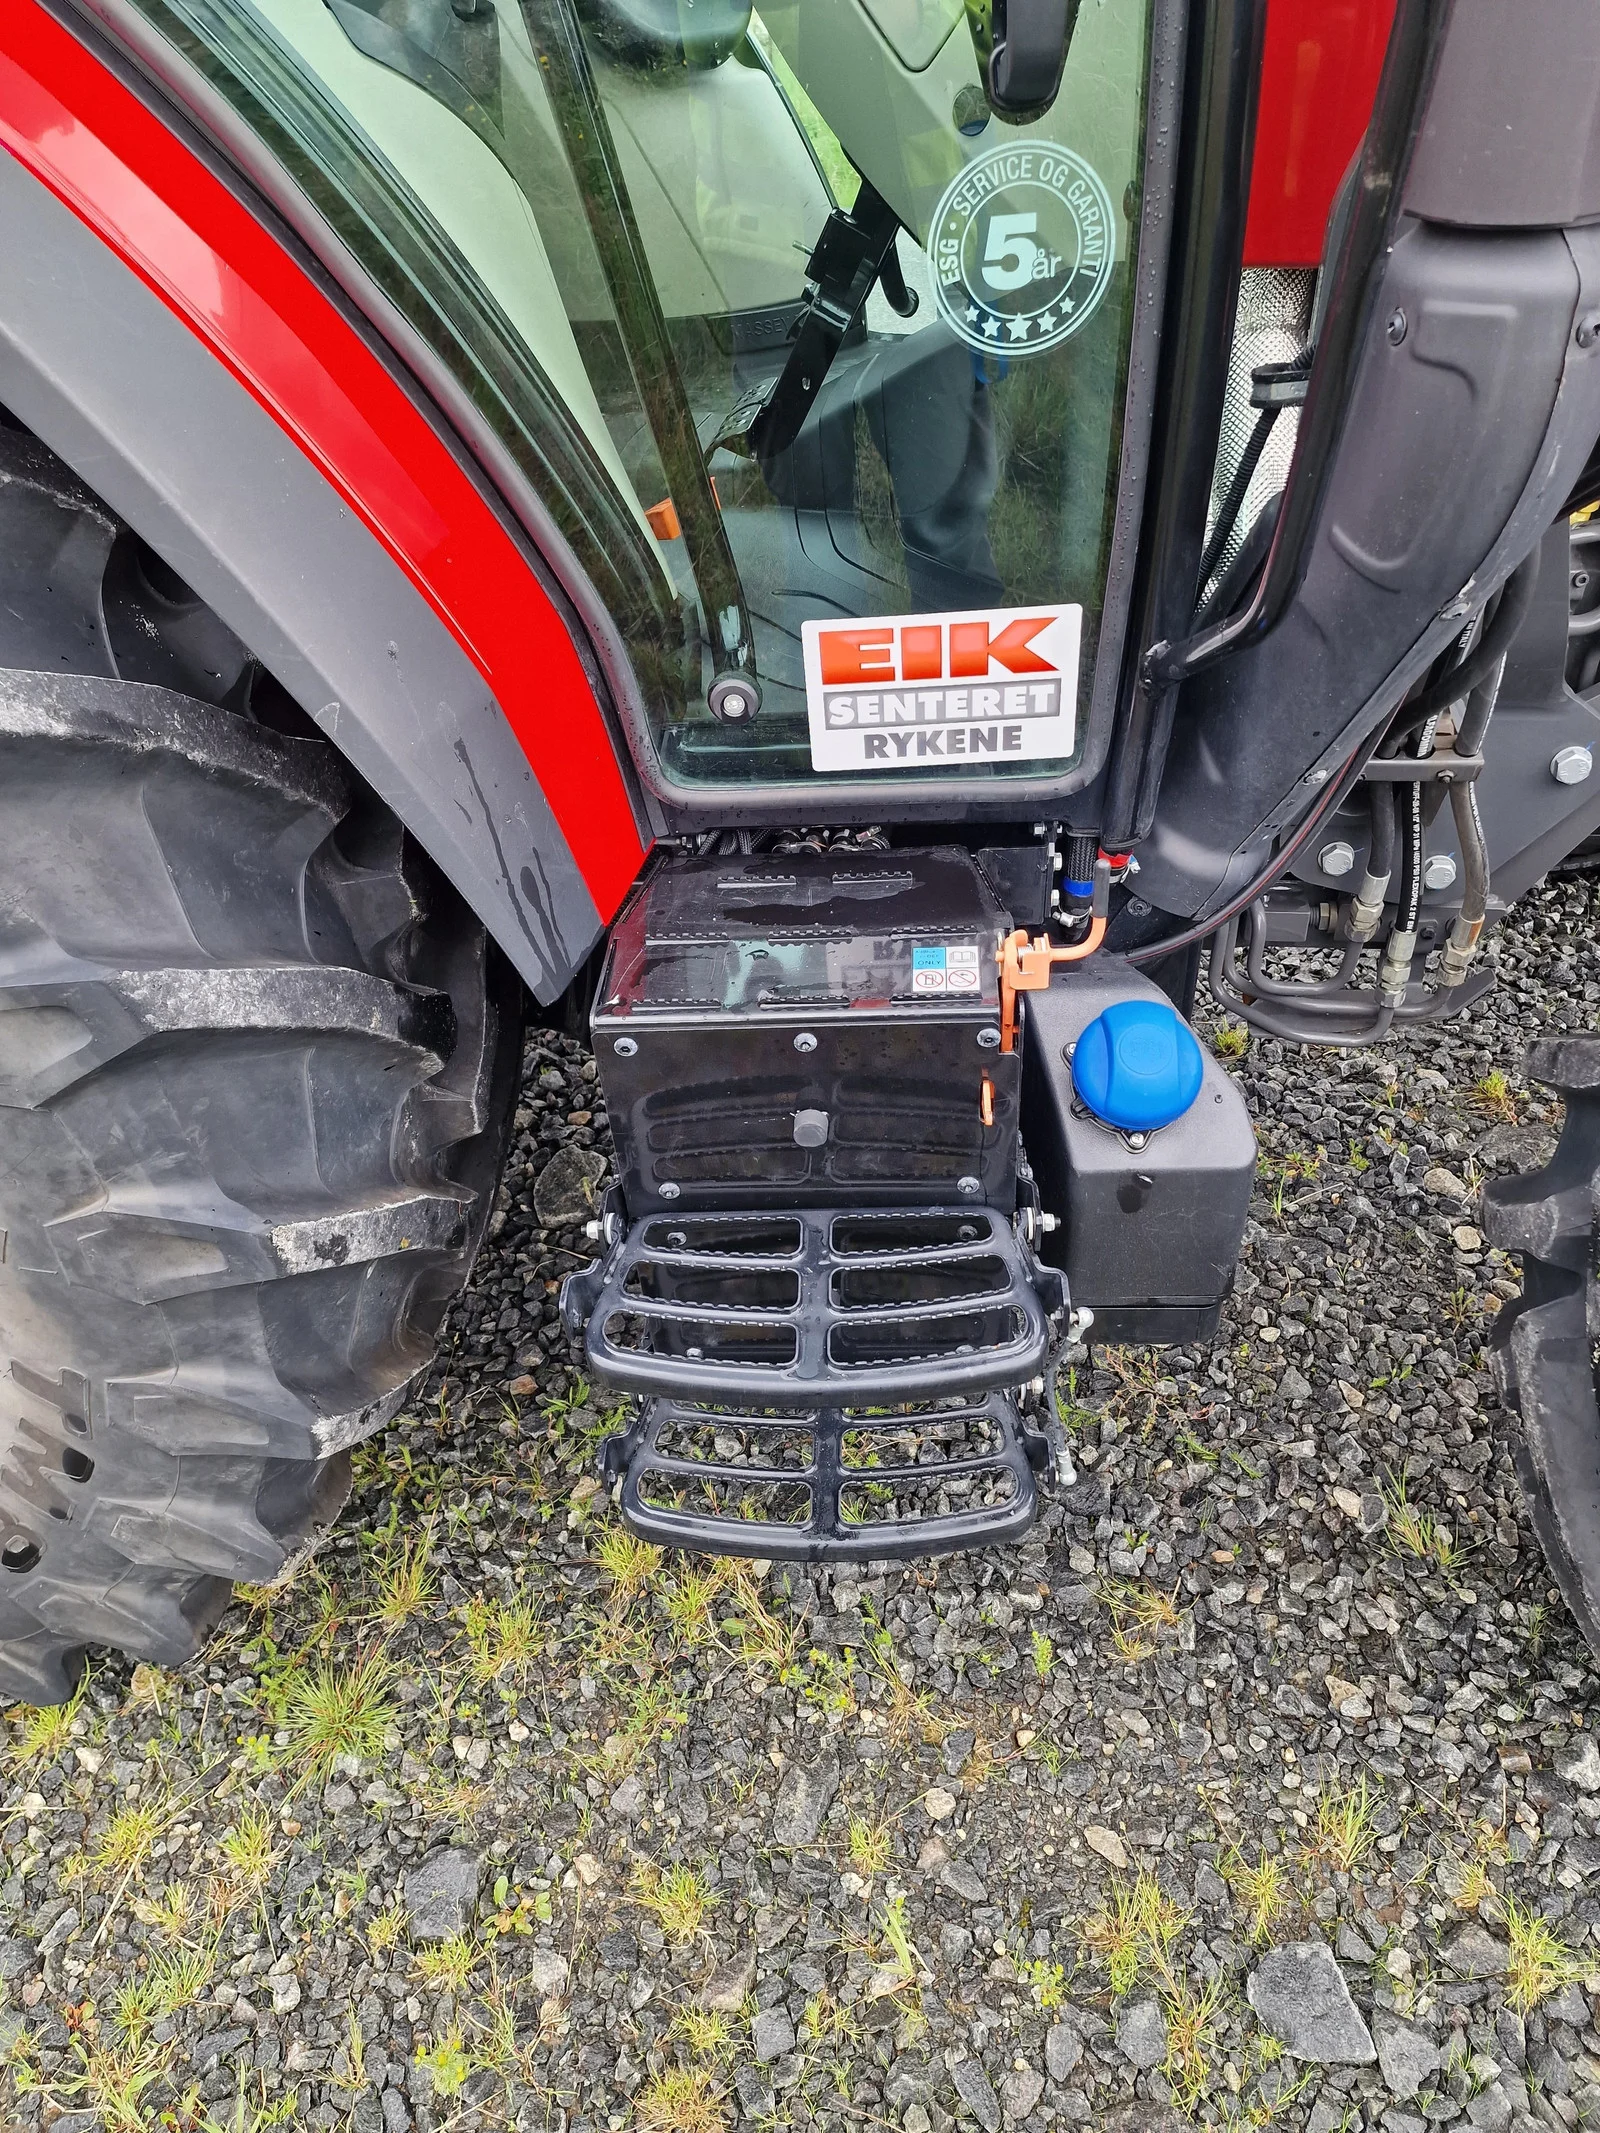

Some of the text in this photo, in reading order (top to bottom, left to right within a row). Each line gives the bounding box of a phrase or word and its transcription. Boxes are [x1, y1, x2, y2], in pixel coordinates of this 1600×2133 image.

[939, 155, 1105, 287] ESG SERVICE OG GARANTI
[981, 212, 1062, 291] 5 år
[818, 616, 1060, 685] EIK
[828, 683, 1056, 726] SENTERET
[863, 725, 1023, 760] RYKENE
[1410, 876, 1420, 907] FLEXOPAK
